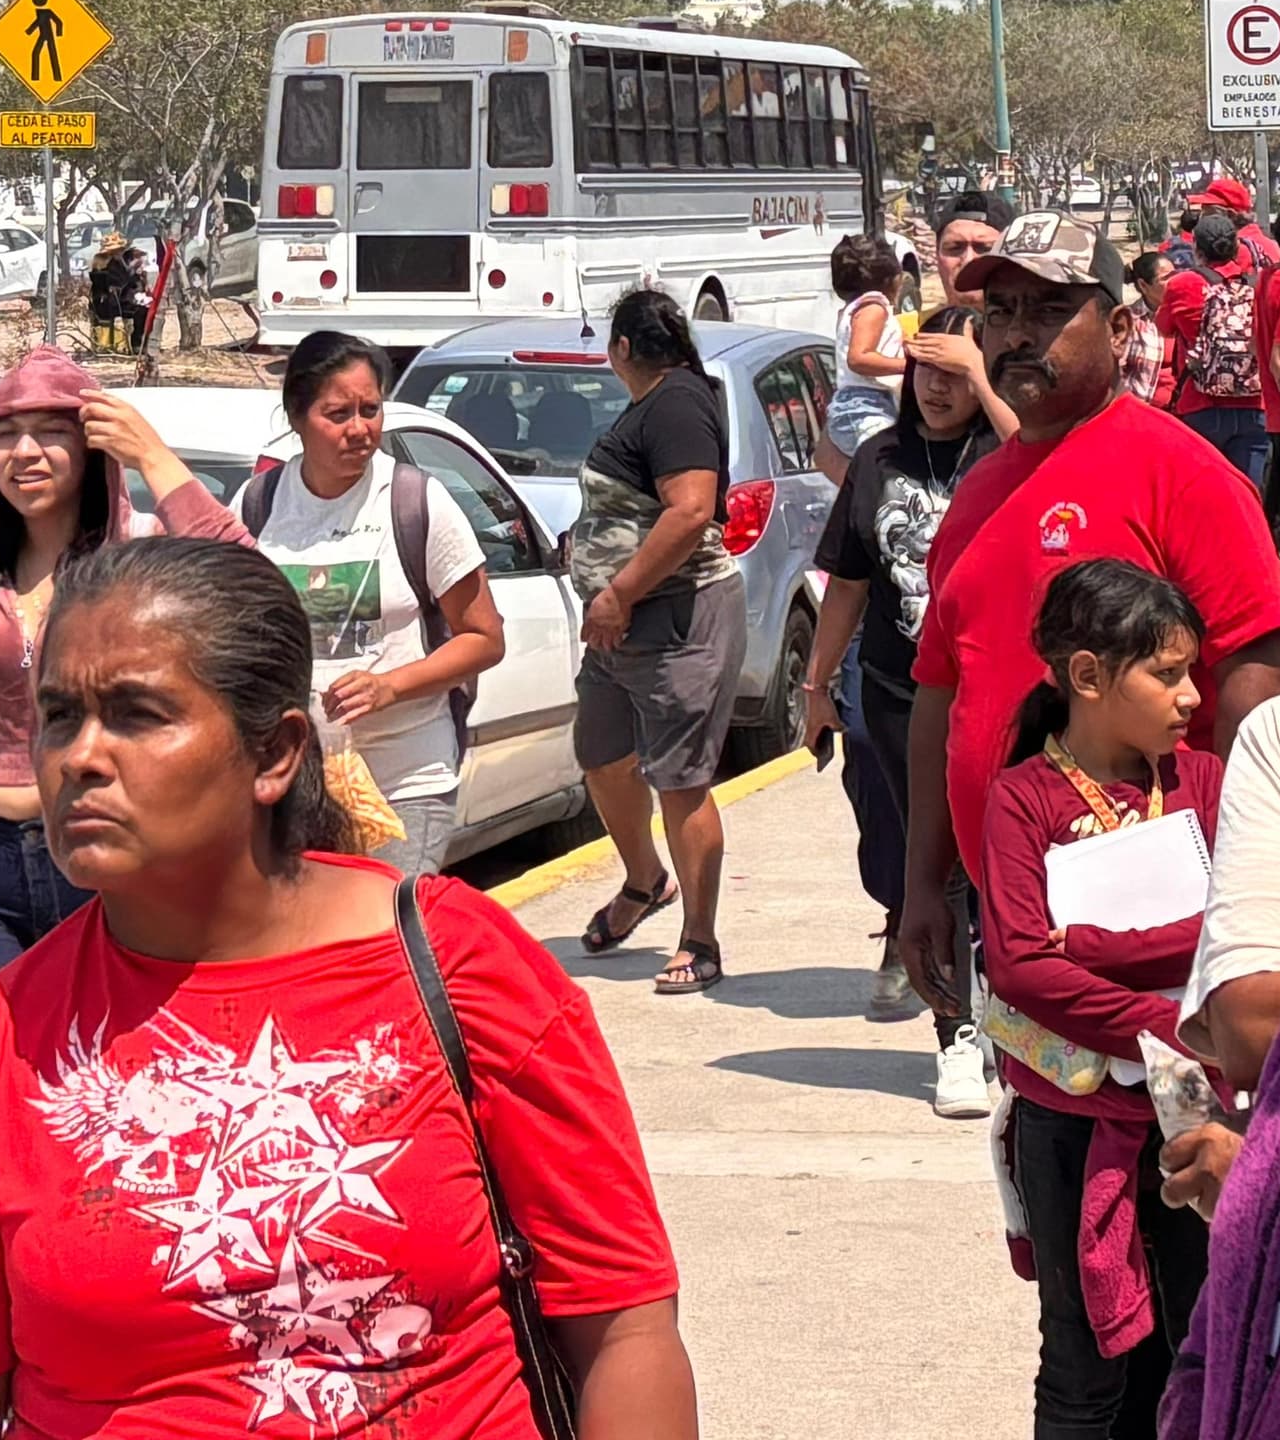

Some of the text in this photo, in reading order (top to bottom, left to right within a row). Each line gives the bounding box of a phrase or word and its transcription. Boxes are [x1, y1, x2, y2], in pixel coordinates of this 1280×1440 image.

[1243, 16, 1272, 54] E
[7, 115, 87, 128] CEDA EL PASO
[11, 132, 83, 145] AL PEATON
